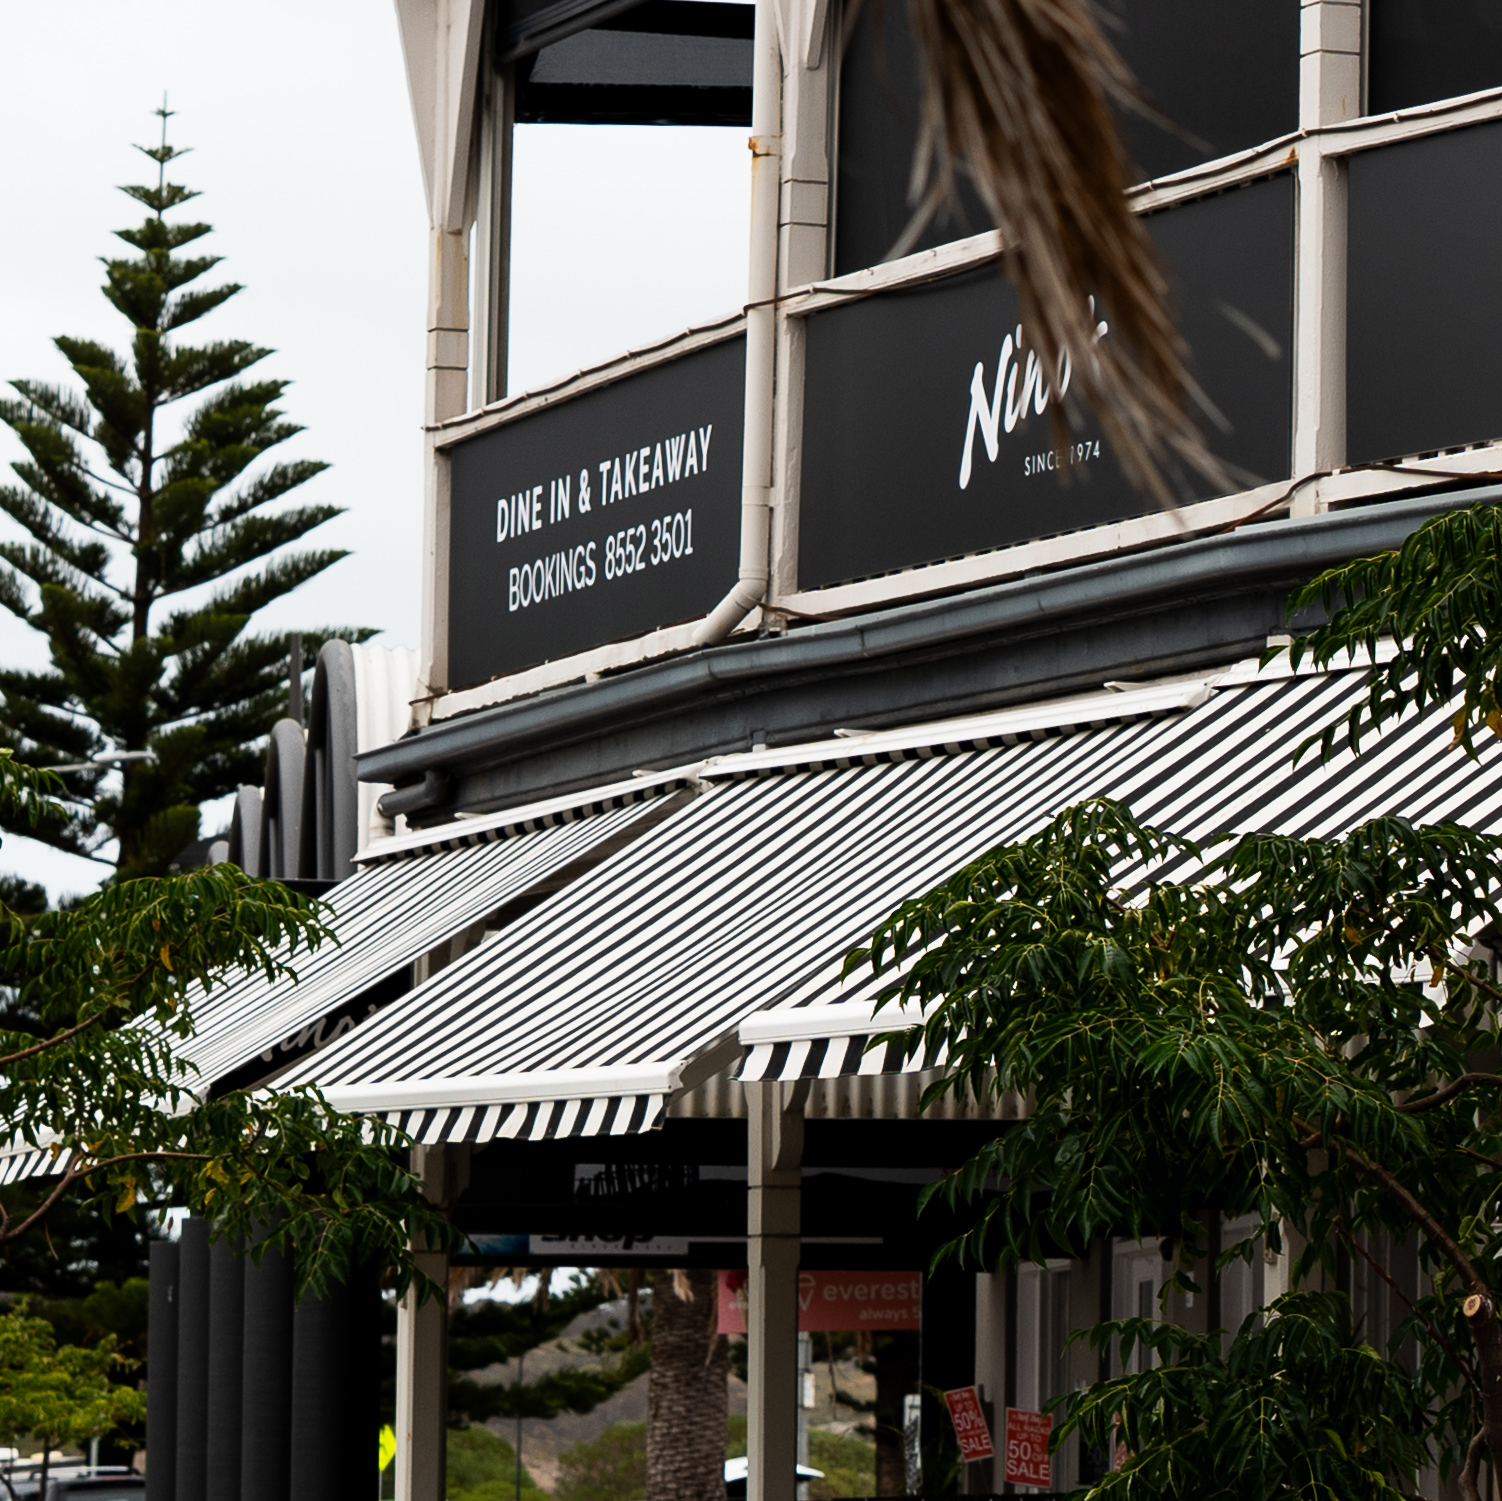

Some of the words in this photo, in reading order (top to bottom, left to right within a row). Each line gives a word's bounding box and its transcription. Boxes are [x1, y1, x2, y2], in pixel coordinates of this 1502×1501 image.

[959, 294, 1108, 490] Nino'
[1070, 440, 1101, 465] 1974
[497, 485, 543, 543] DINE
[550, 474, 571, 524] IN
[578, 468, 591, 514] &
[599, 424, 713, 506] TAKEAWAY
[508, 541, 597, 612] BOOKINGS
[605, 524, 646, 580] 8552
[650, 508, 694, 565] 3501
[823, 1279, 920, 1302] everest
[858, 1307, 908, 1323] always
[954, 1405, 985, 1432] 50%
[961, 1434, 992, 1454] SALE
[1008, 1440, 1032, 1461] 50
[1006, 1459, 1051, 1481] SALE
